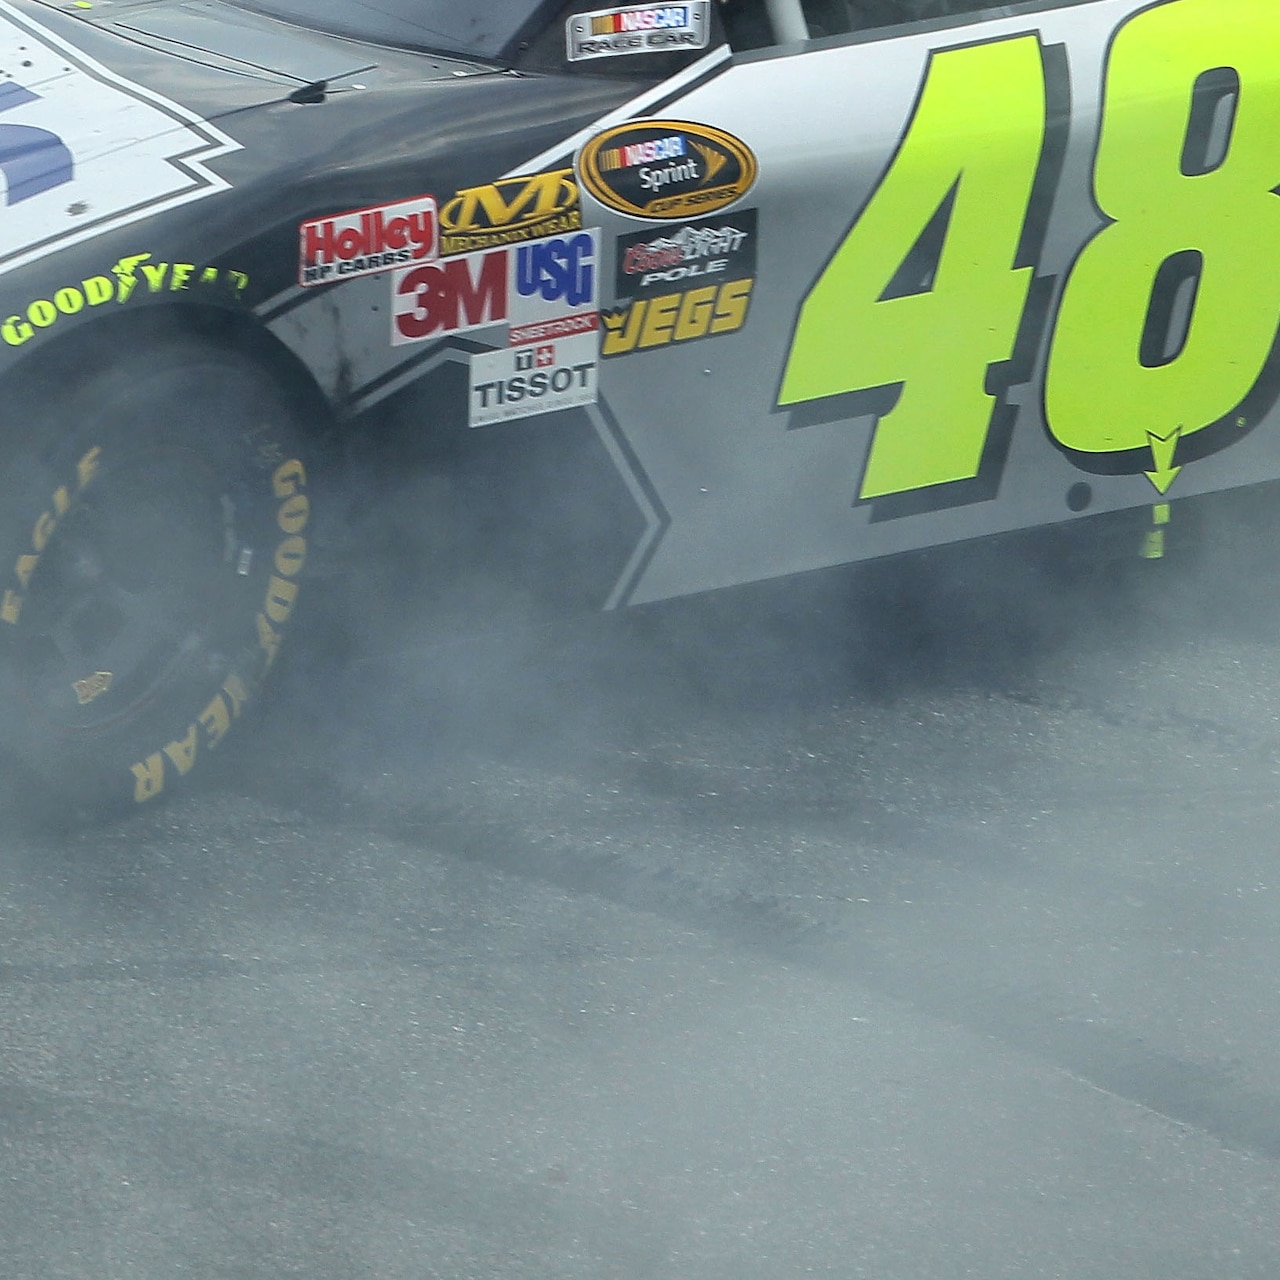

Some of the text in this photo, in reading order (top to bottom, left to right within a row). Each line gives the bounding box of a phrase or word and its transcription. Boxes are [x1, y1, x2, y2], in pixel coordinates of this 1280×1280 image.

[620, 6, 688, 32] NASCAR
[577, 32, 698, 54] RACE CAR
[625, 135, 686, 166] NASCAR
[639, 158, 699, 192] Sprint
[306, 210, 433, 262] Holley
[441, 209, 582, 255] MECHANIX WEAR
[337, 250, 411, 276] CARBS
[516, 233, 594, 307] USG
[640, 259, 729, 286] POLE
[395, 250, 509, 338] 3M
[475, 362, 596, 408] TISSOT
